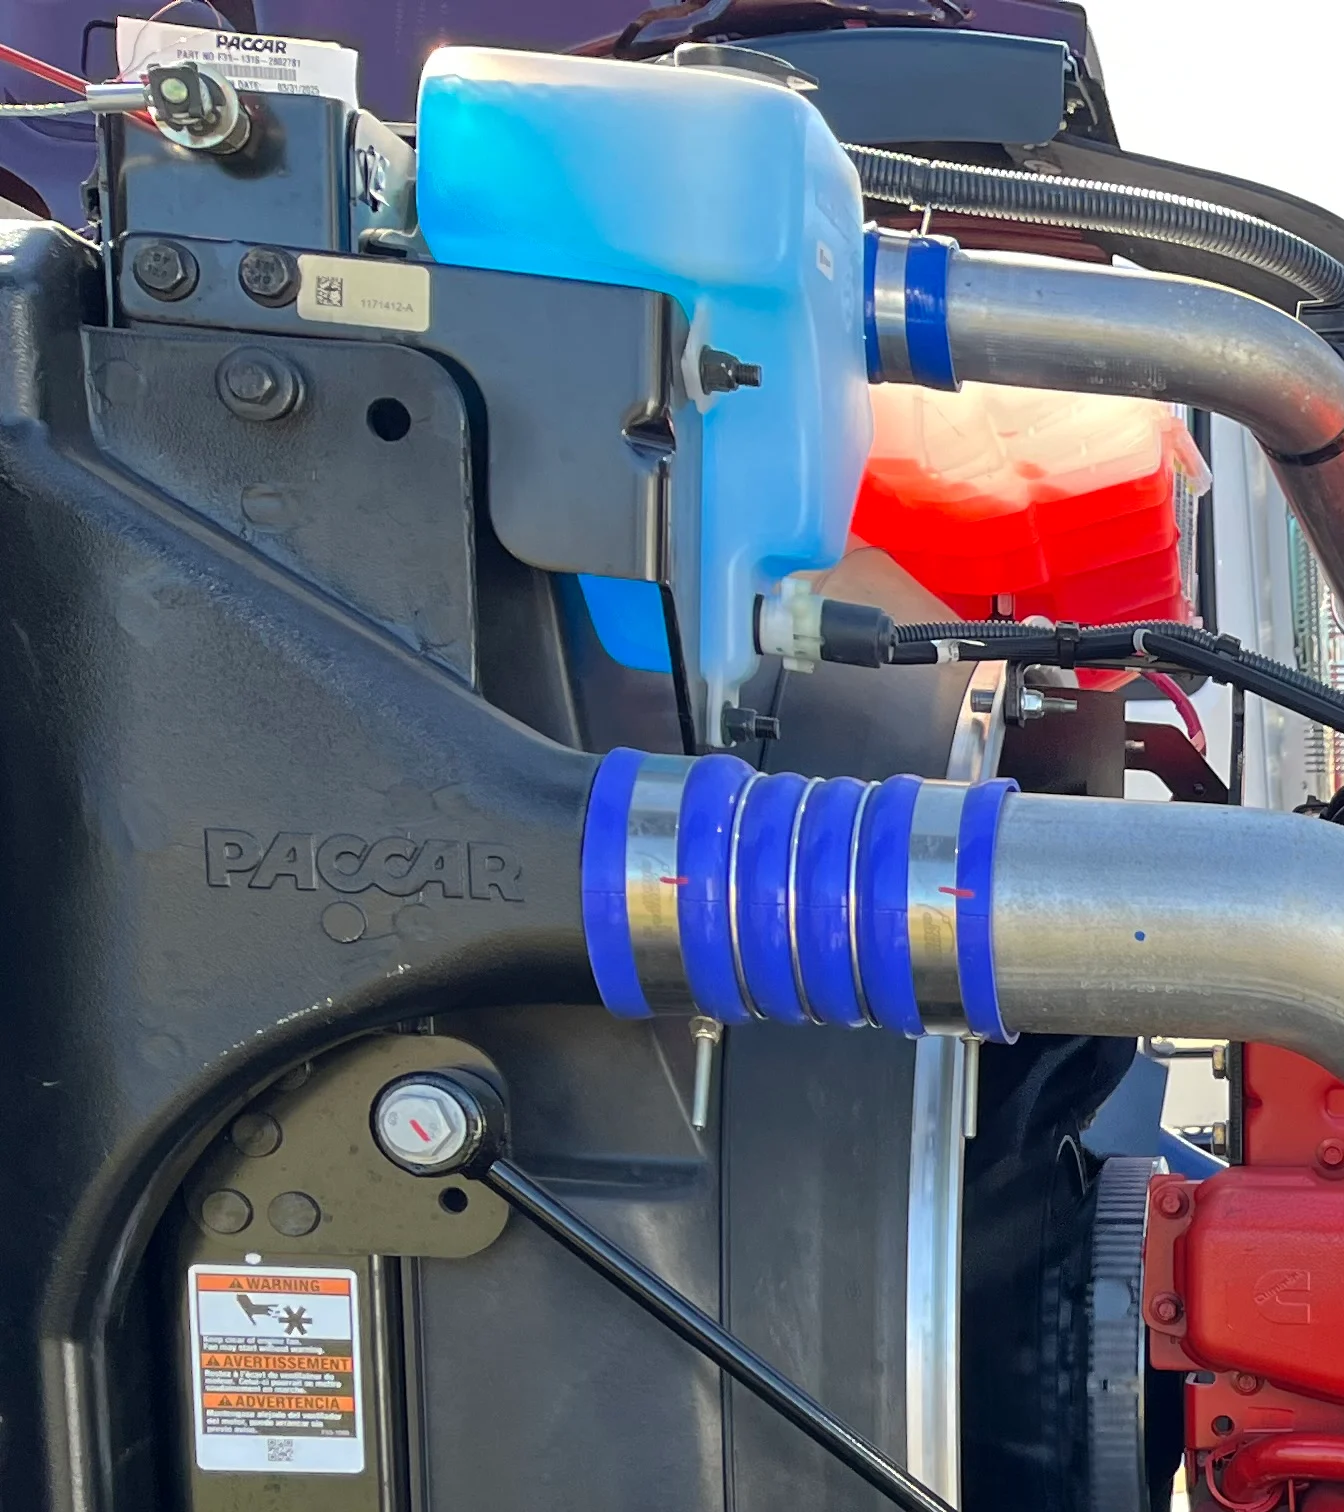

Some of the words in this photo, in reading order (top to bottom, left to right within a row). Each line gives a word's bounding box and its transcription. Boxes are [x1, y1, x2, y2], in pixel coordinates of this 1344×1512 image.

[216, 34, 287, 54] PACCAR
[360, 298, 414, 314] 1171412-A
[204, 828, 526, 902] PACCAR
[246, 1277, 320, 1292] WARNING
[223, 1355, 350, 1371] AVERTISSEMENT
[235, 1394, 340, 1410] ADVERTENCIA
